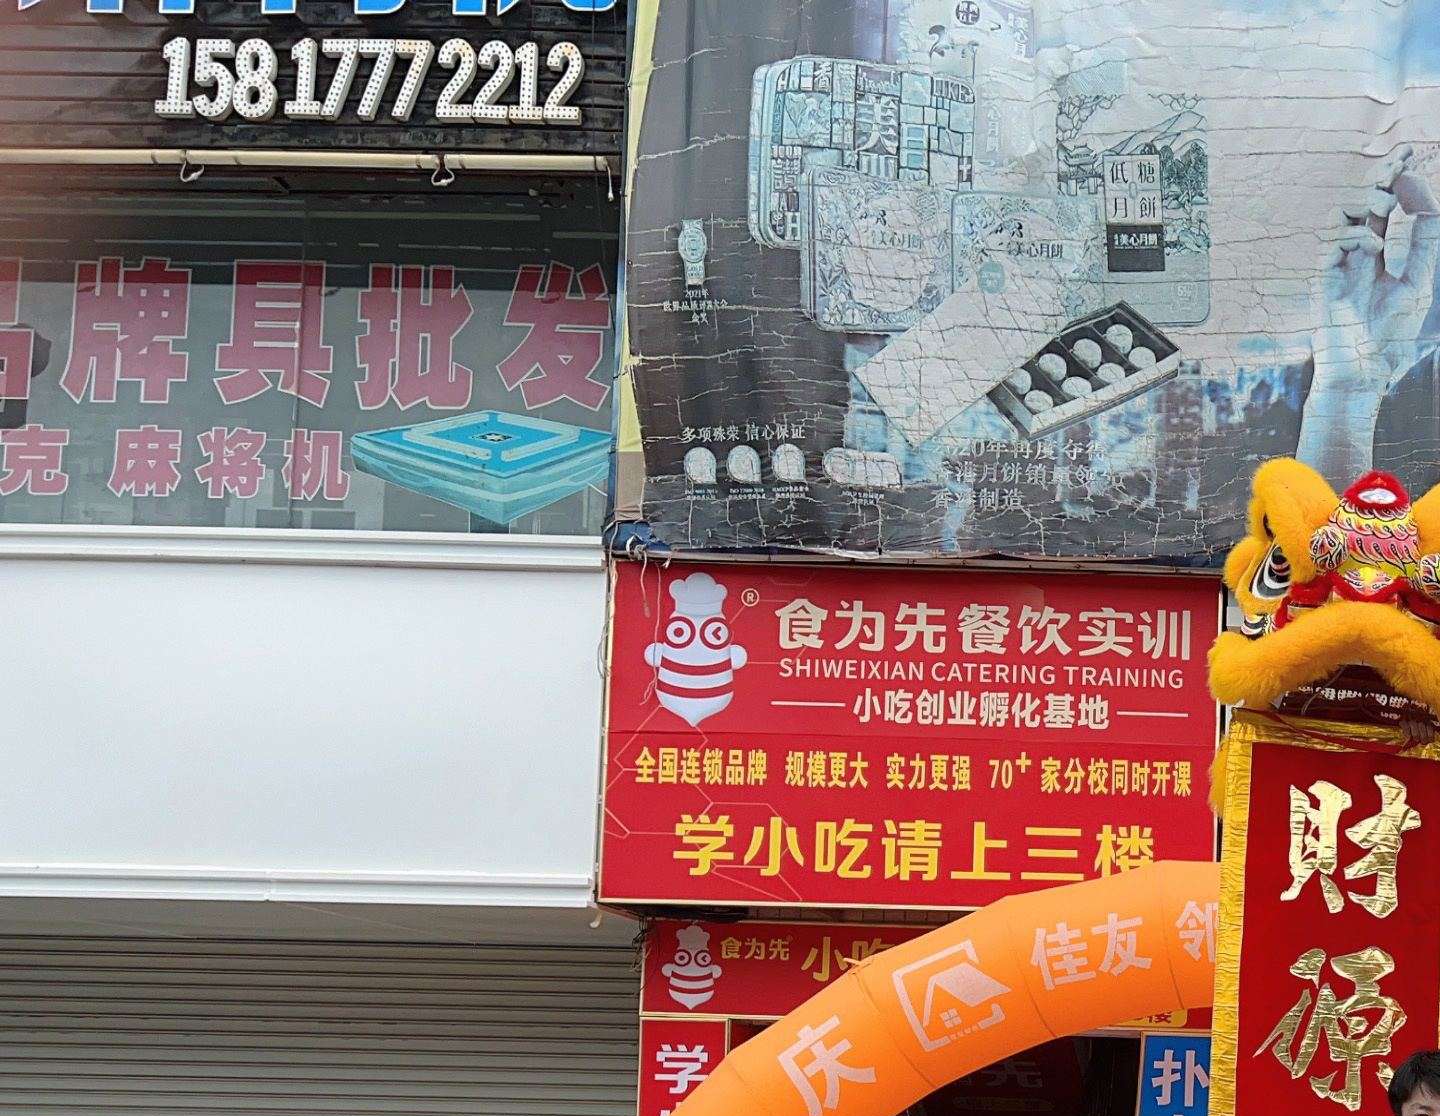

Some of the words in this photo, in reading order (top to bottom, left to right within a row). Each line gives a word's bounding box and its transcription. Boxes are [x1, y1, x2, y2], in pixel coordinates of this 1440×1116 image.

[0, 256, 612, 411] 牌具批发
[108, 425, 350, 501] 麻将机
[775, 598, 1192, 661] 食为先餐饮实训
[779, 658, 925, 682] SHIWEIXIAN
[931, 661, 1056, 686] CATERING
[1063, 666, 1184, 690] TRAINING
[852, 688, 1111, 731] 小吃创业孵化基地
[634, 746, 768, 787] 全国连锁品牌
[785, 750, 869, 790] 规模更大
[886, 753, 971, 792] 实力更强
[1040, 758, 1193, 798] 家分校同时开课
[672, 813, 1155, 881] 学小吃请上三楼
[720, 936, 790, 961] 食为先
